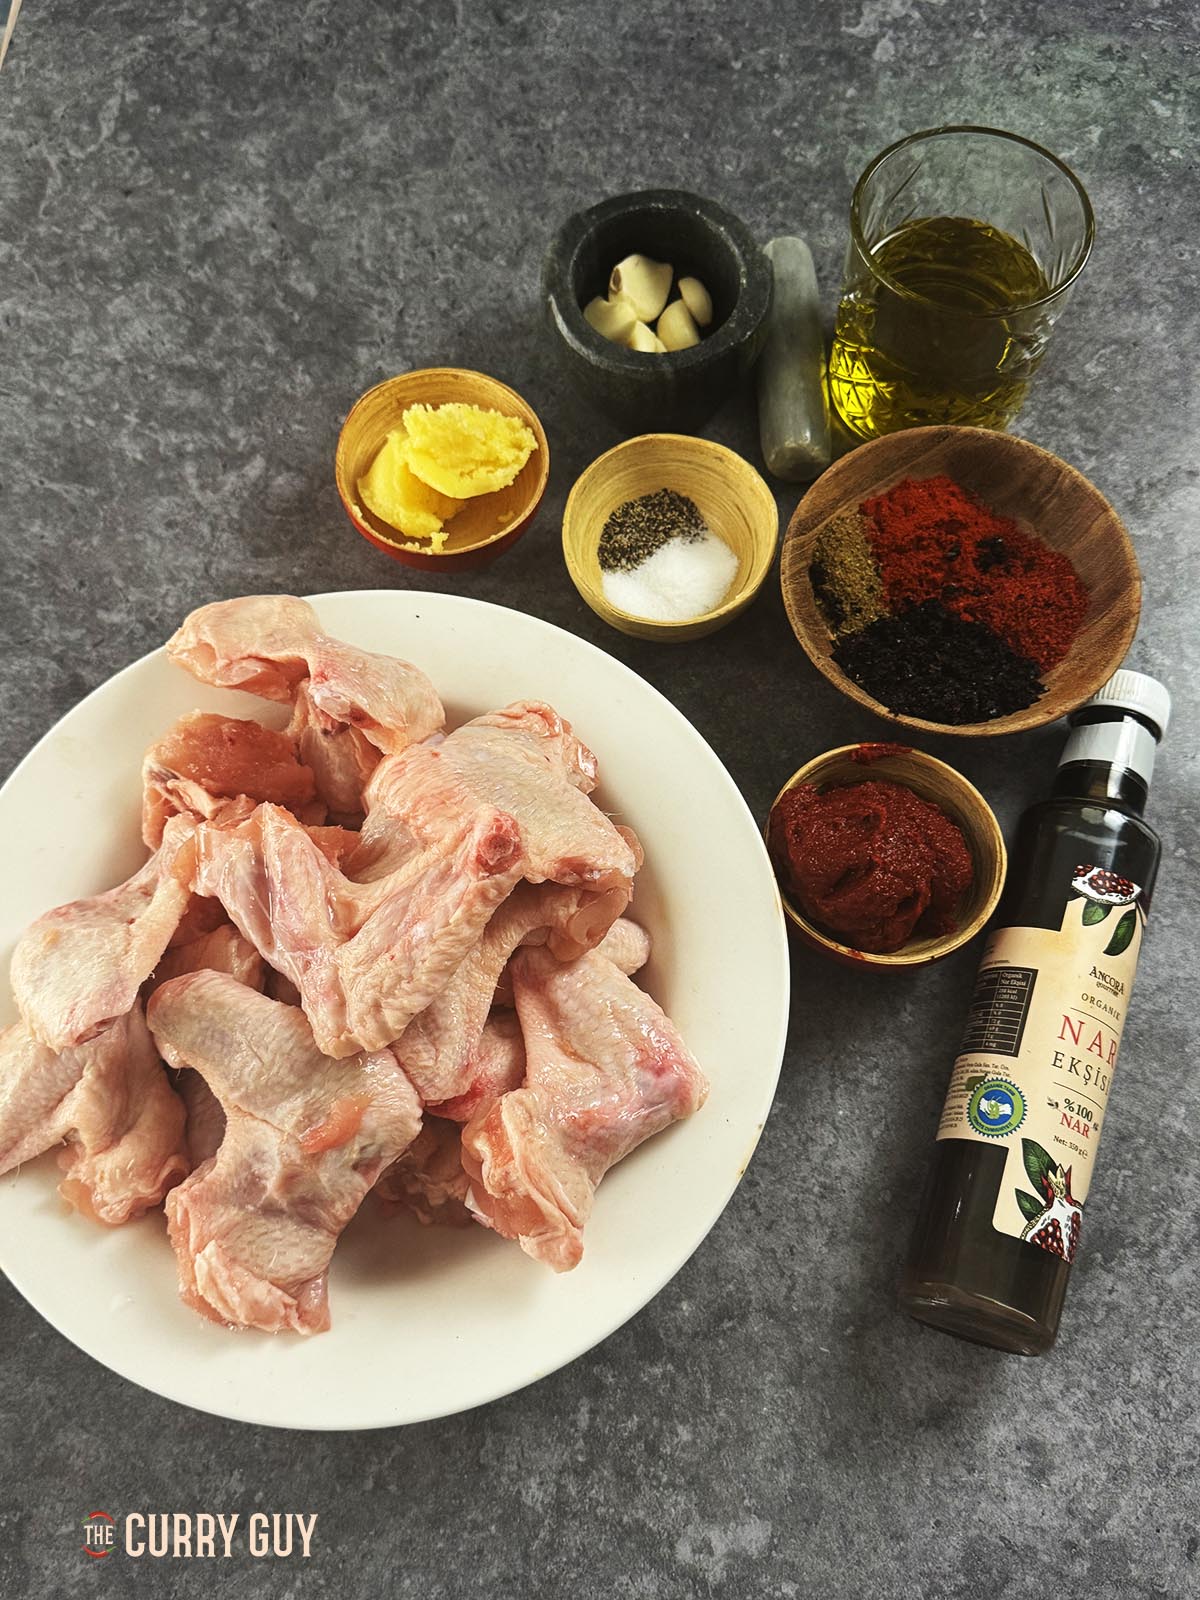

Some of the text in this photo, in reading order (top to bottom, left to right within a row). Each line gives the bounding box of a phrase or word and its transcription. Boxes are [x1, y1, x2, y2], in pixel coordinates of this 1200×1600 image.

[1089, 966, 1124, 995] ANCORA
[1057, 1014, 1118, 1069] NAR
[1063, 1098, 1093, 1122] %100
[1060, 1112, 1090, 1140] NAR
